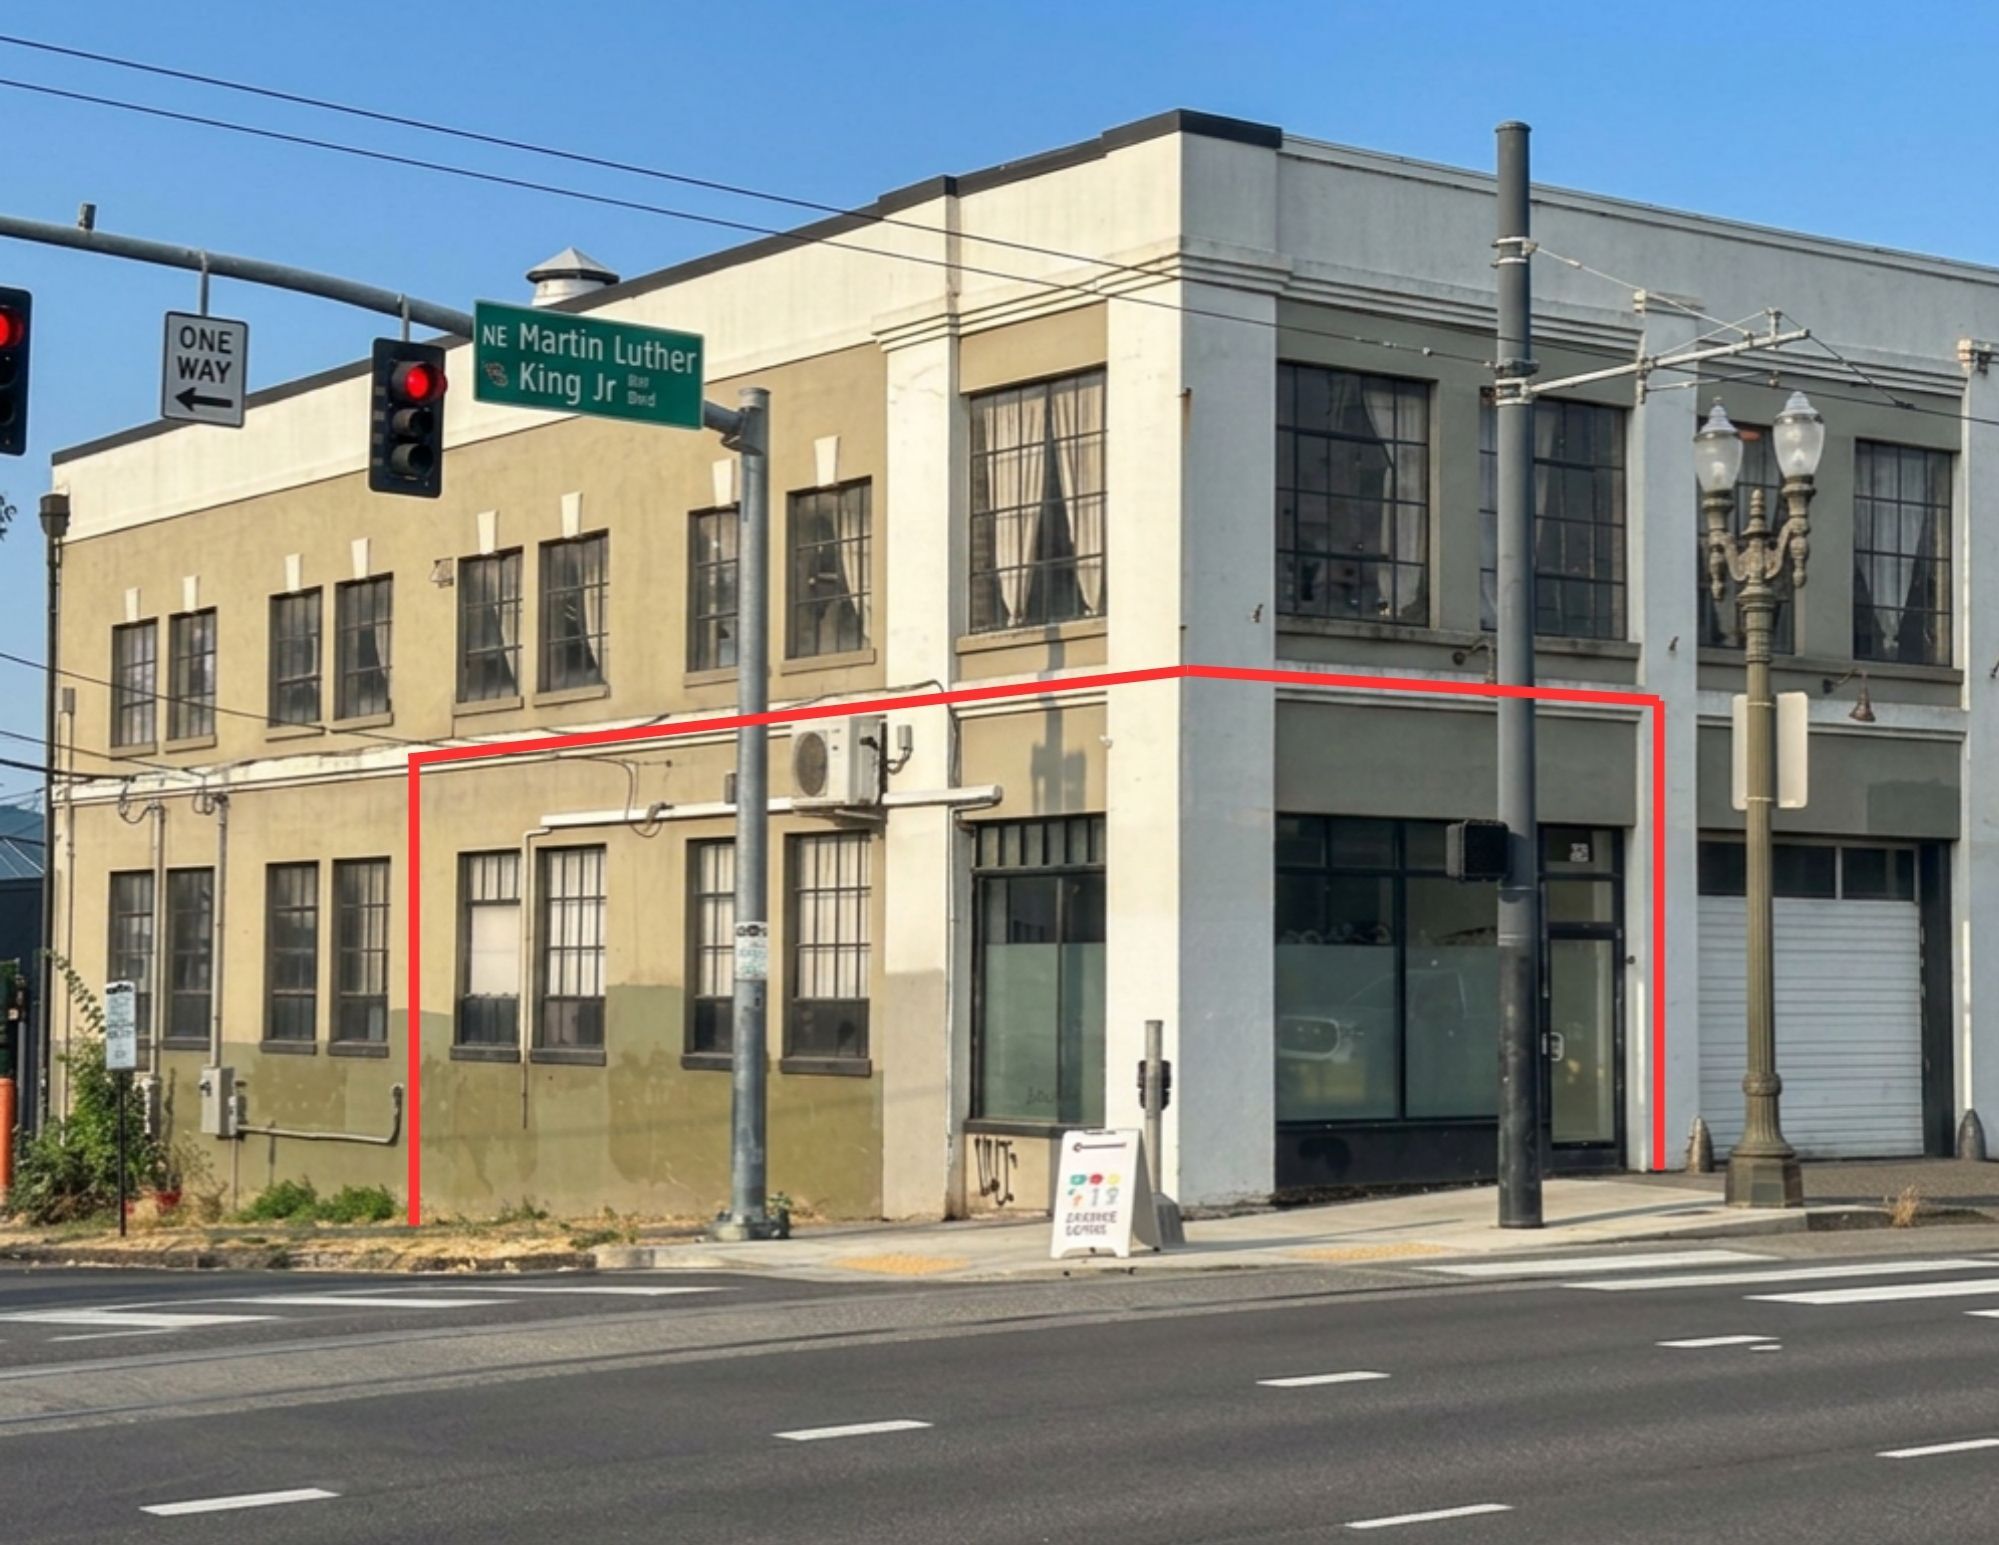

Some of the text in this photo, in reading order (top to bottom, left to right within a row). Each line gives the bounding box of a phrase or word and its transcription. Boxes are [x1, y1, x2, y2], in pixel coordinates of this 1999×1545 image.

[180, 325, 232, 355] ONE
[482, 322, 697, 374] NE Martin Luther
[177, 355, 232, 384] WAY
[519, 362, 617, 405] King Jr
